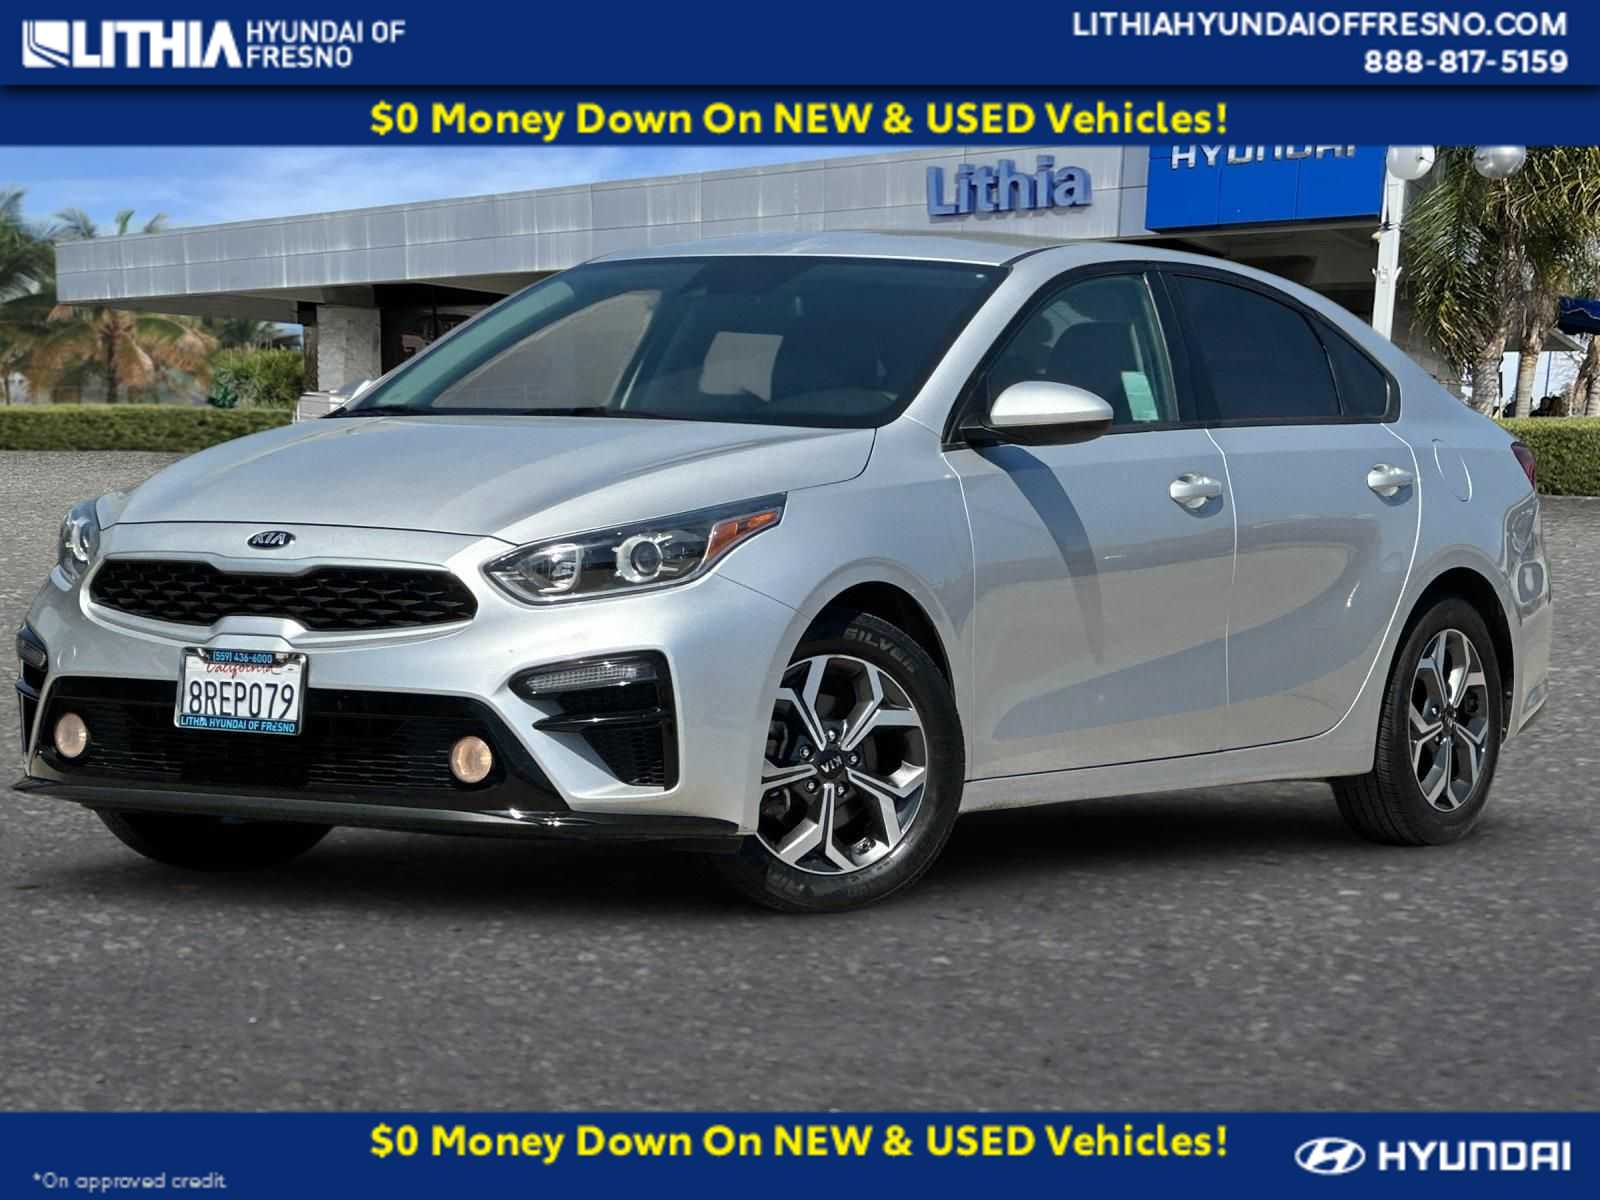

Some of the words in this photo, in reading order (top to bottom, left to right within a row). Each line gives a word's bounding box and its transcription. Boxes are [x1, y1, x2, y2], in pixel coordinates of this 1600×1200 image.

[926, 154, 1093, 216] Lithia
[252, 532, 287, 545] KIA
[189, 680, 294, 719] 8REP079
[208, 718, 247, 730] HYUNDAI
[248, 719, 259, 730] OF
